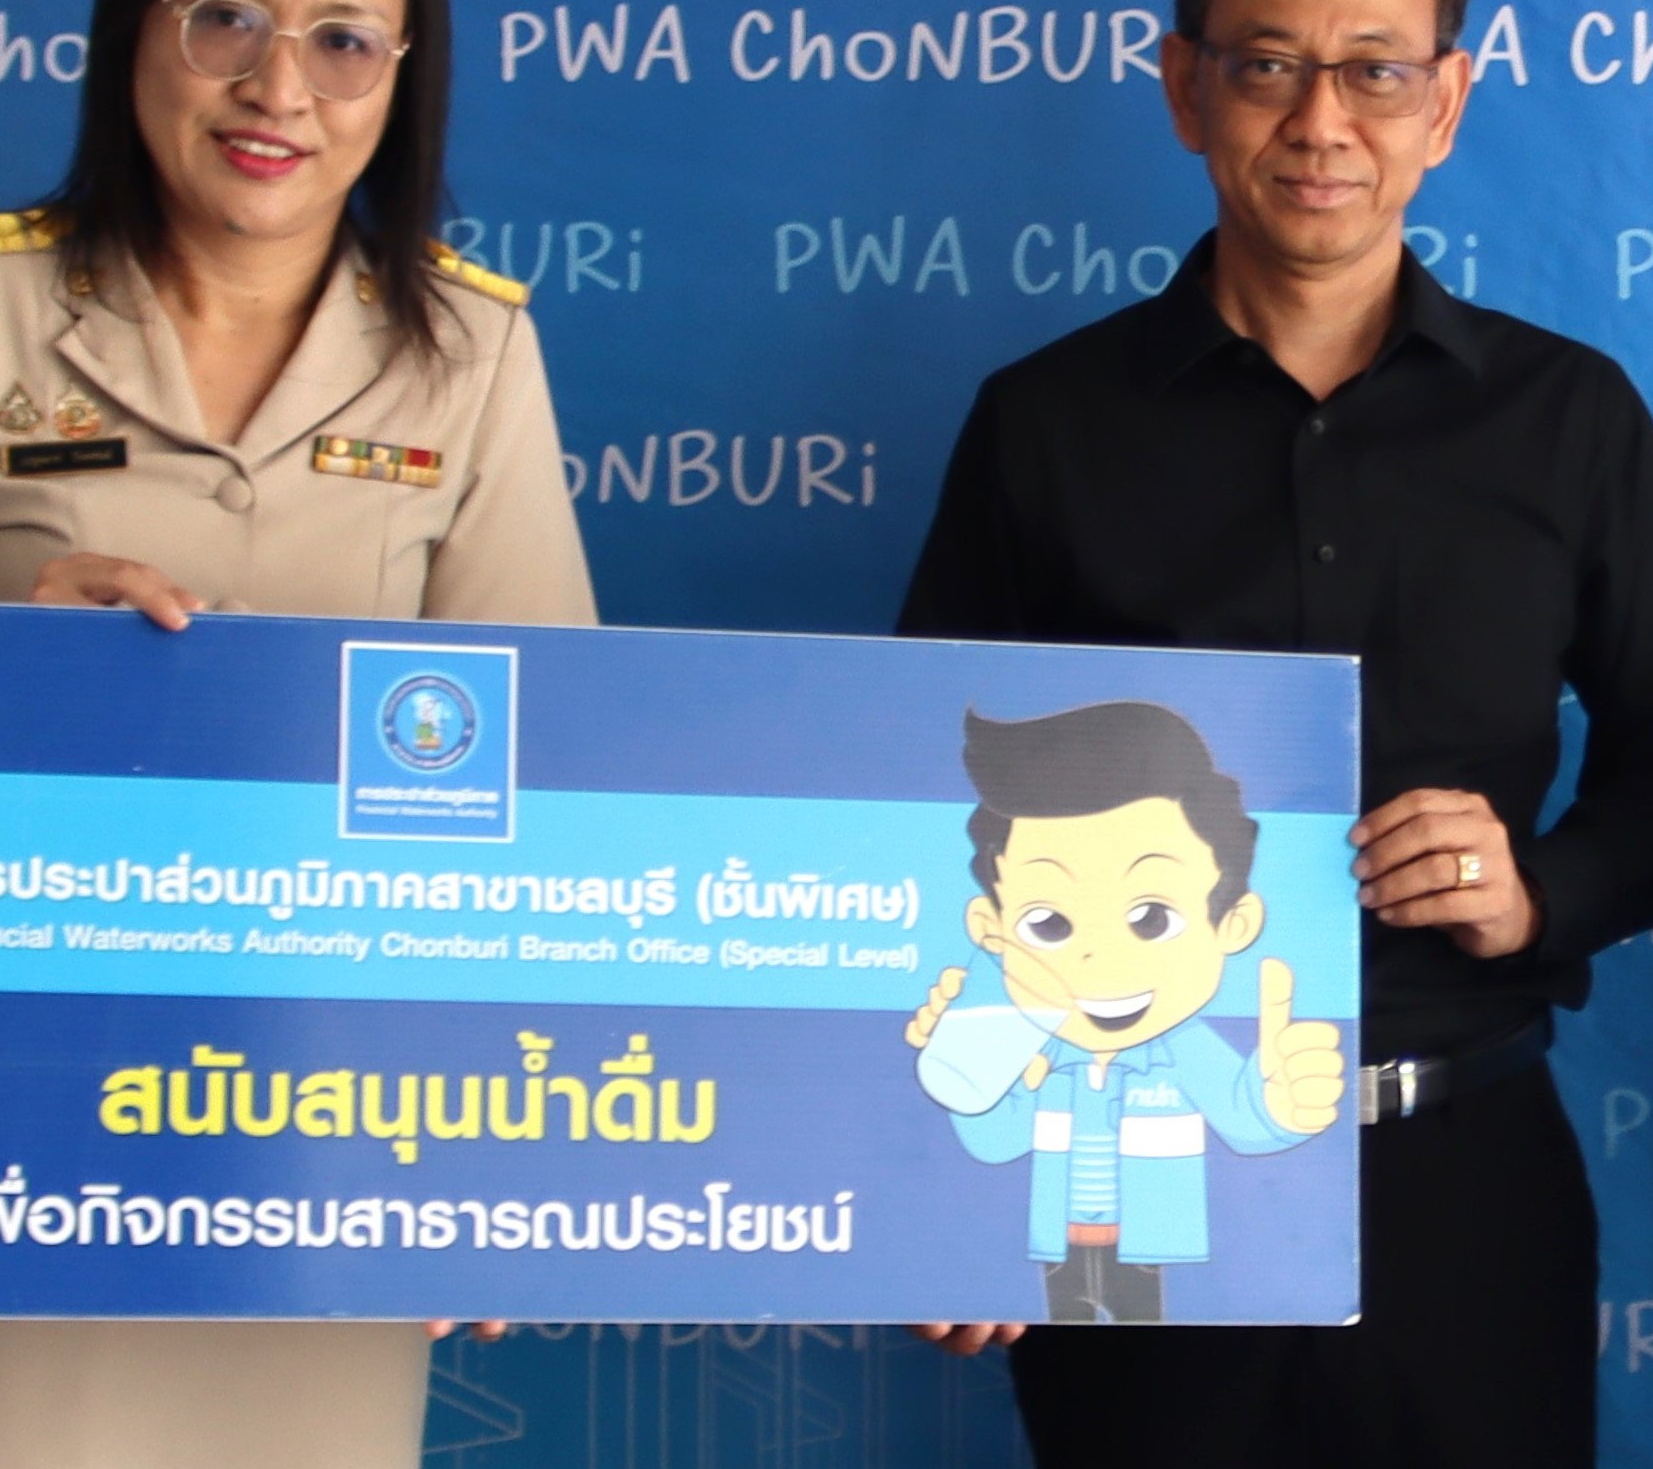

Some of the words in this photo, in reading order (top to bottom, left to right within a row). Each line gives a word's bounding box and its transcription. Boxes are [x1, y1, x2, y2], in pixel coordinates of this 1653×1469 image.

[501, 3, 690, 83] PWA
[731, 6, 1163, 83] ChoNBUR
[775, 215, 969, 296] PWA
[696, 856, 919, 929] (ชั้นพิเศษ)
[63, 924, 234, 953] Waterworks
[242, 928, 372, 961] Authority
[380, 931, 509, 959] Chonburi
[518, 934, 618, 962] Branch
[627, 937, 711, 964] Office
[719, 939, 829, 970] (Special
[838, 943, 919, 972] Level)
[99, 1031, 714, 1163] สนับสนุนน้ำดื่ม
